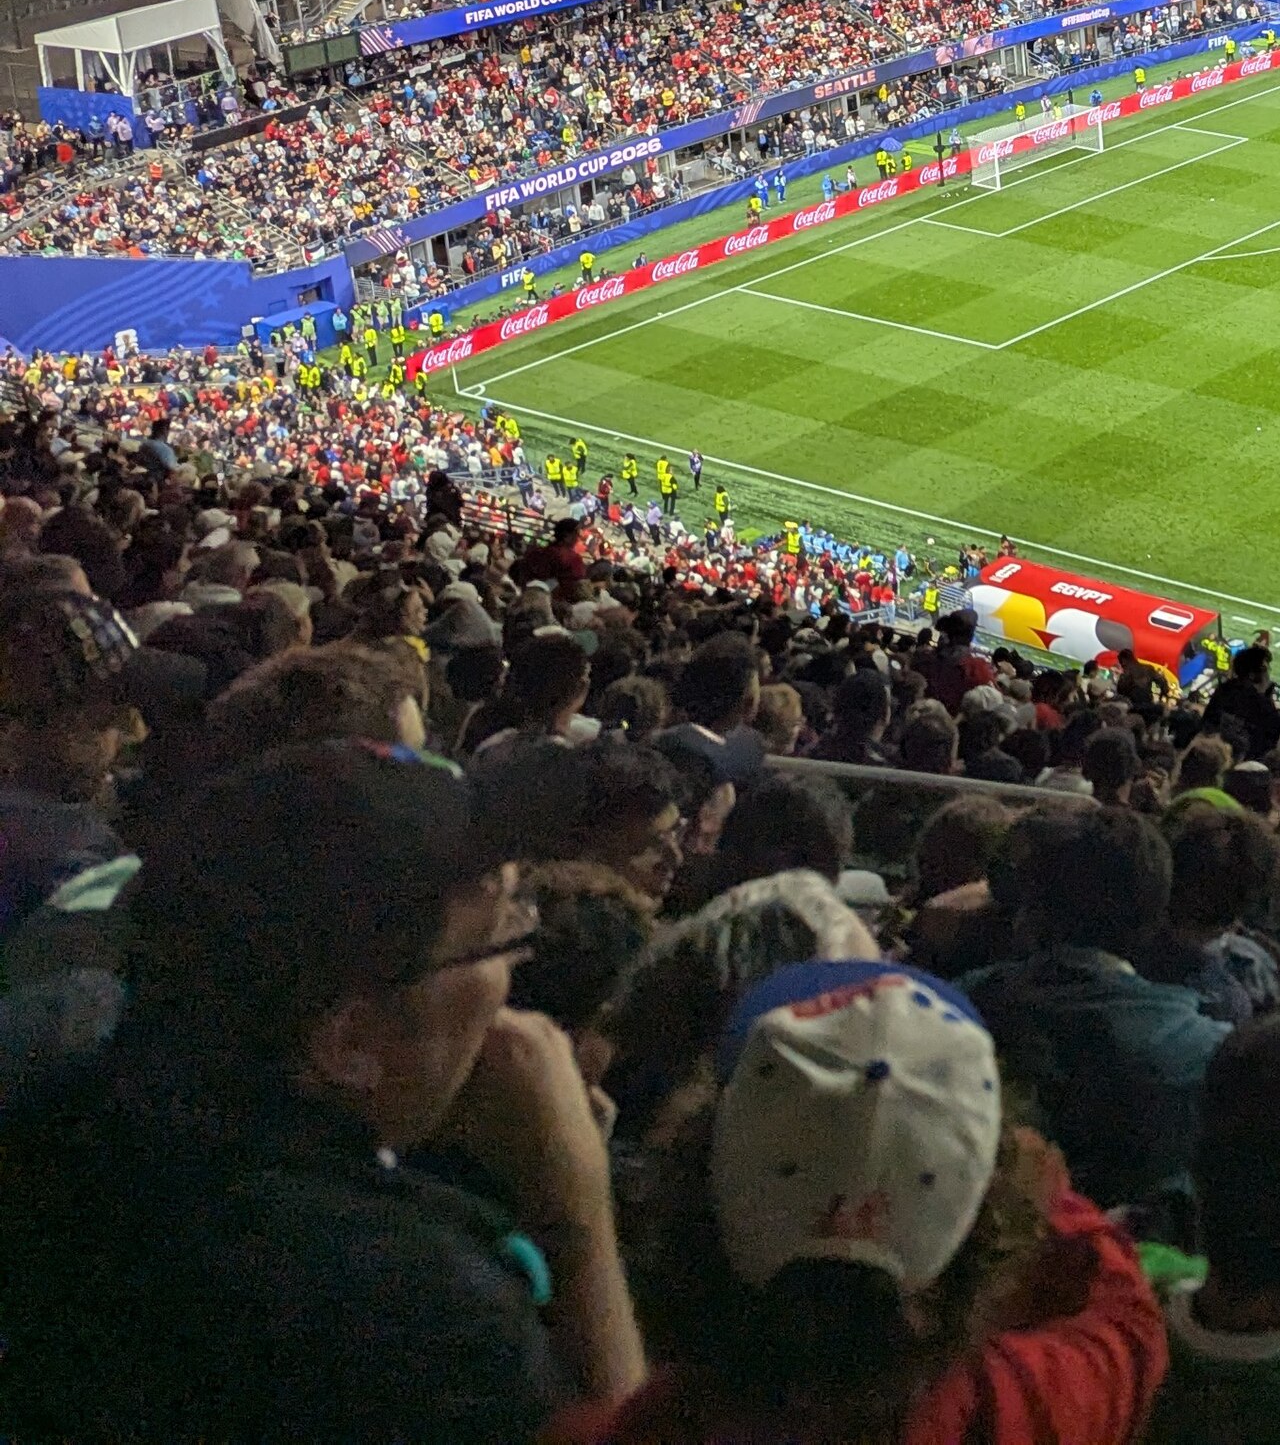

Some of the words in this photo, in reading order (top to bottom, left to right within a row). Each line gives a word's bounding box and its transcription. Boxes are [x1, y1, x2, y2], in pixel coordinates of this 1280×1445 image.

[465, 6, 494, 26] FIFA
[813, 69, 877, 101] SEATTLE
[485, 188, 520, 212] FIFA
[519, 167, 578, 197] WORLD
[578, 154, 609, 178] CUP
[610, 137, 664, 167] 2026
[1051, 581, 1114, 605] EGYPT
